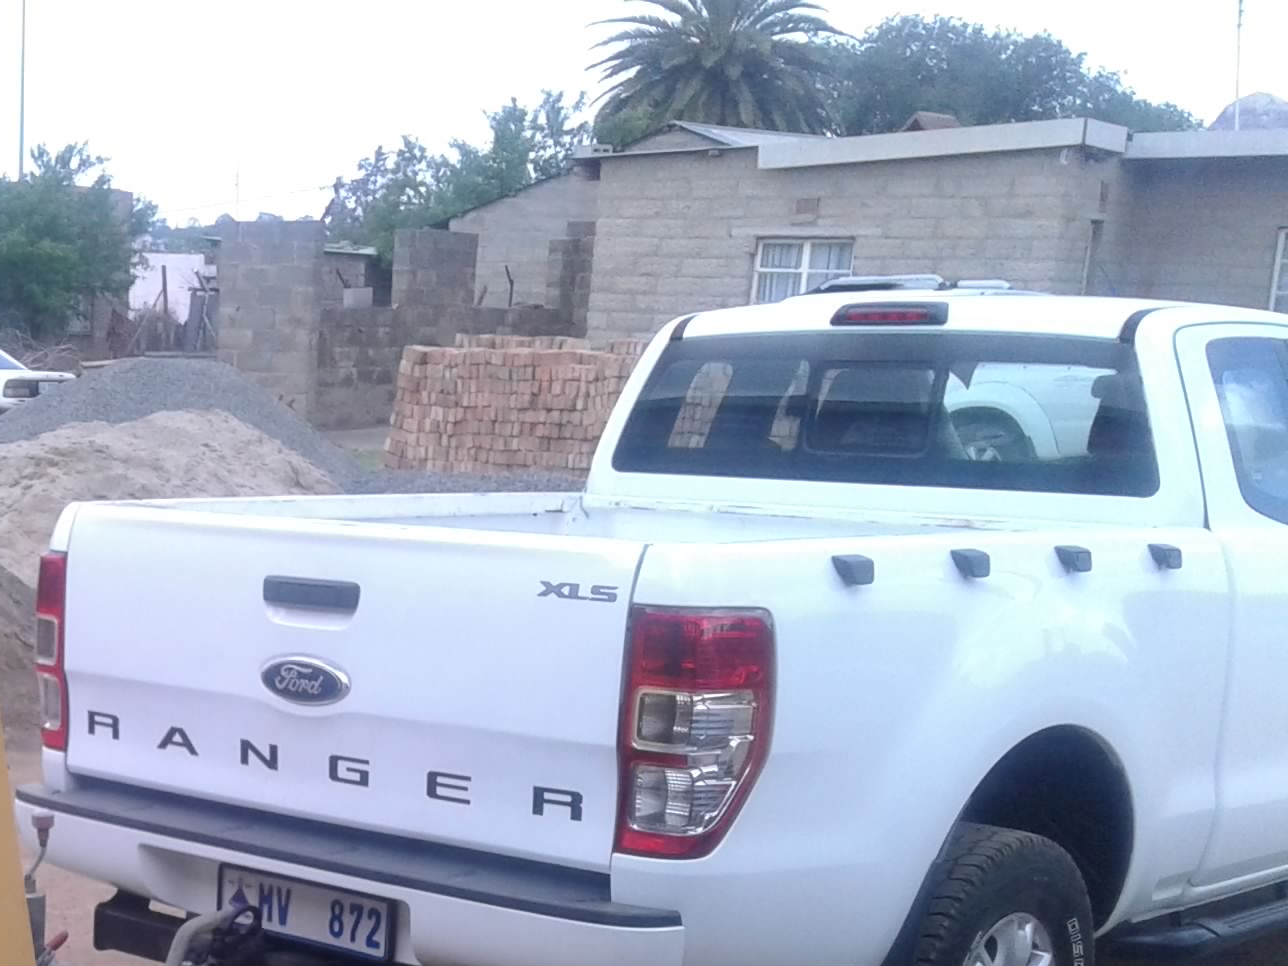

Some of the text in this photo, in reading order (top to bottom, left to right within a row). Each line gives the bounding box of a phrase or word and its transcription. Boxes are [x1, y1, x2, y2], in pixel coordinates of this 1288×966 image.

[537, 580, 619, 602] XLS
[274, 664, 324, 695] Ford
[87, 710, 583, 821] RANGER
[329, 899, 382, 949] 872
